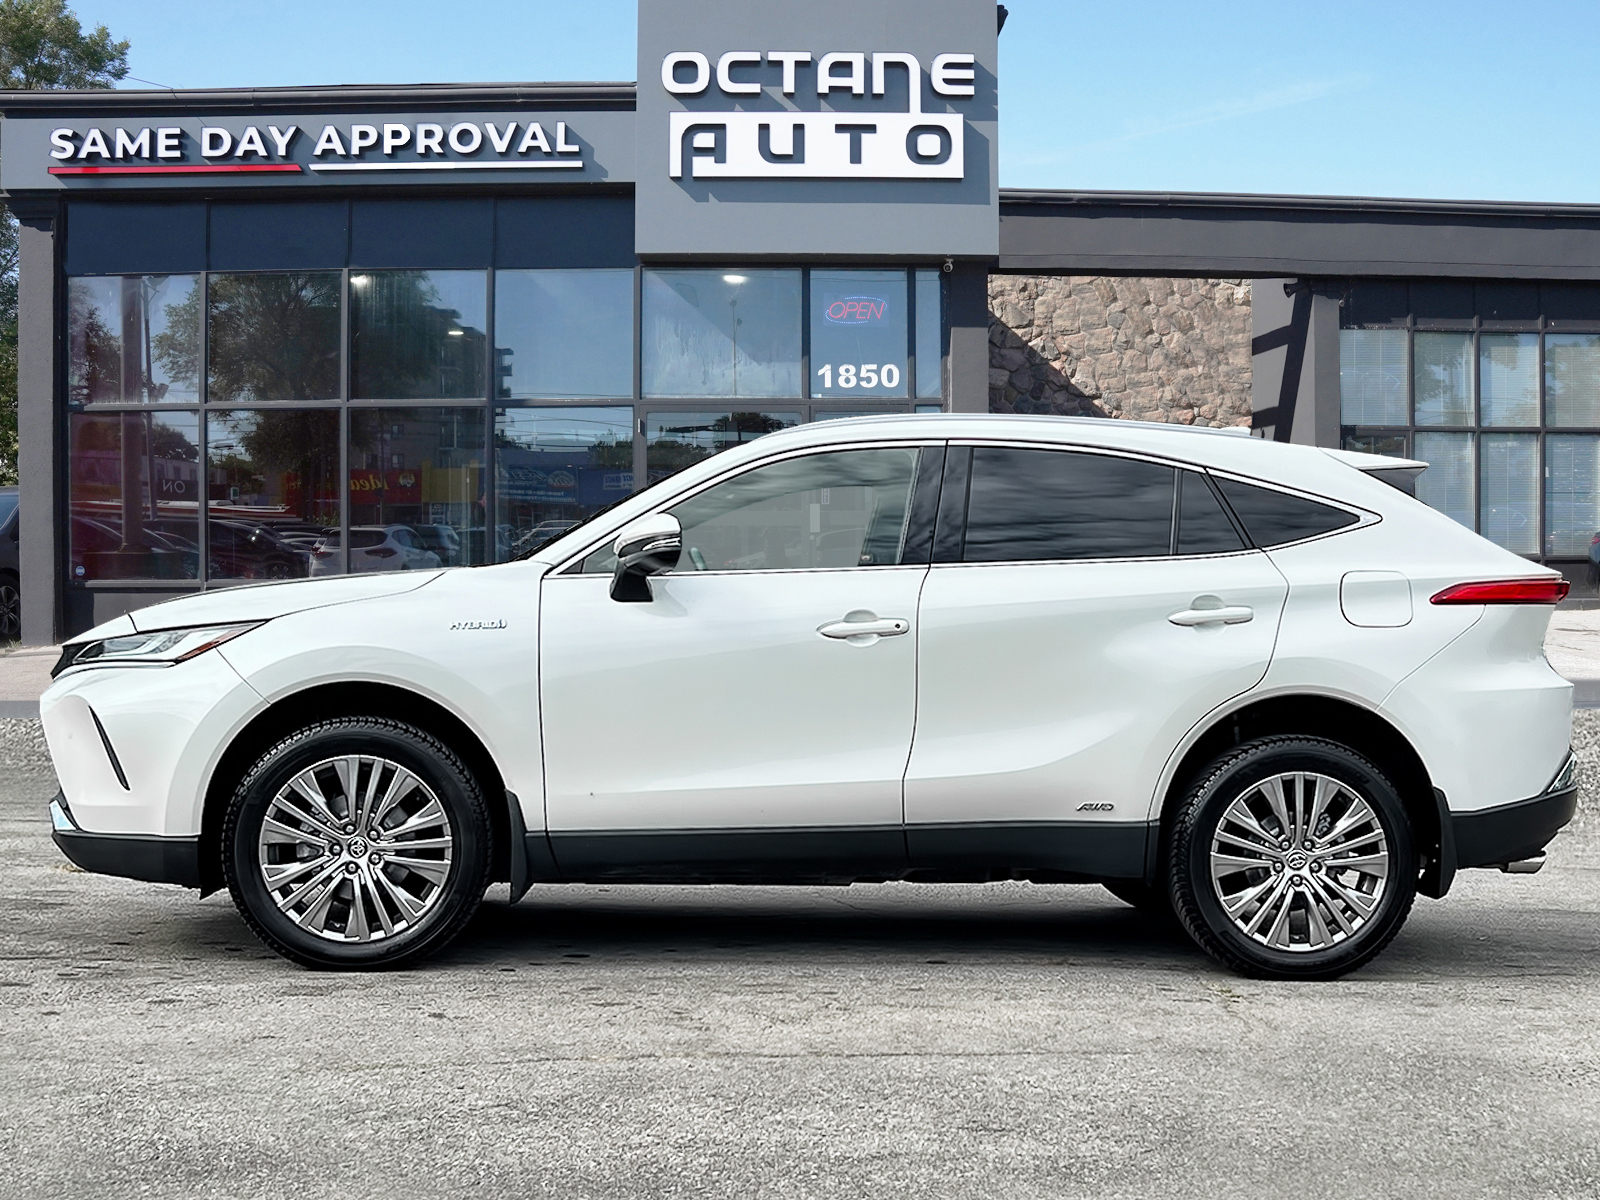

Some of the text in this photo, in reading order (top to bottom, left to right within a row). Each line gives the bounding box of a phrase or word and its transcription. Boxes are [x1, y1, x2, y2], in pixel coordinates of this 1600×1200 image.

[660, 50, 976, 97] OCTANE
[49, 120, 581, 160] SAME DAY APPROVAL
[680, 122, 953, 178] AUTO
[828, 301, 885, 319] OPEN
[817, 363, 900, 389] 1850
[449, 619, 507, 631] HYBRID
